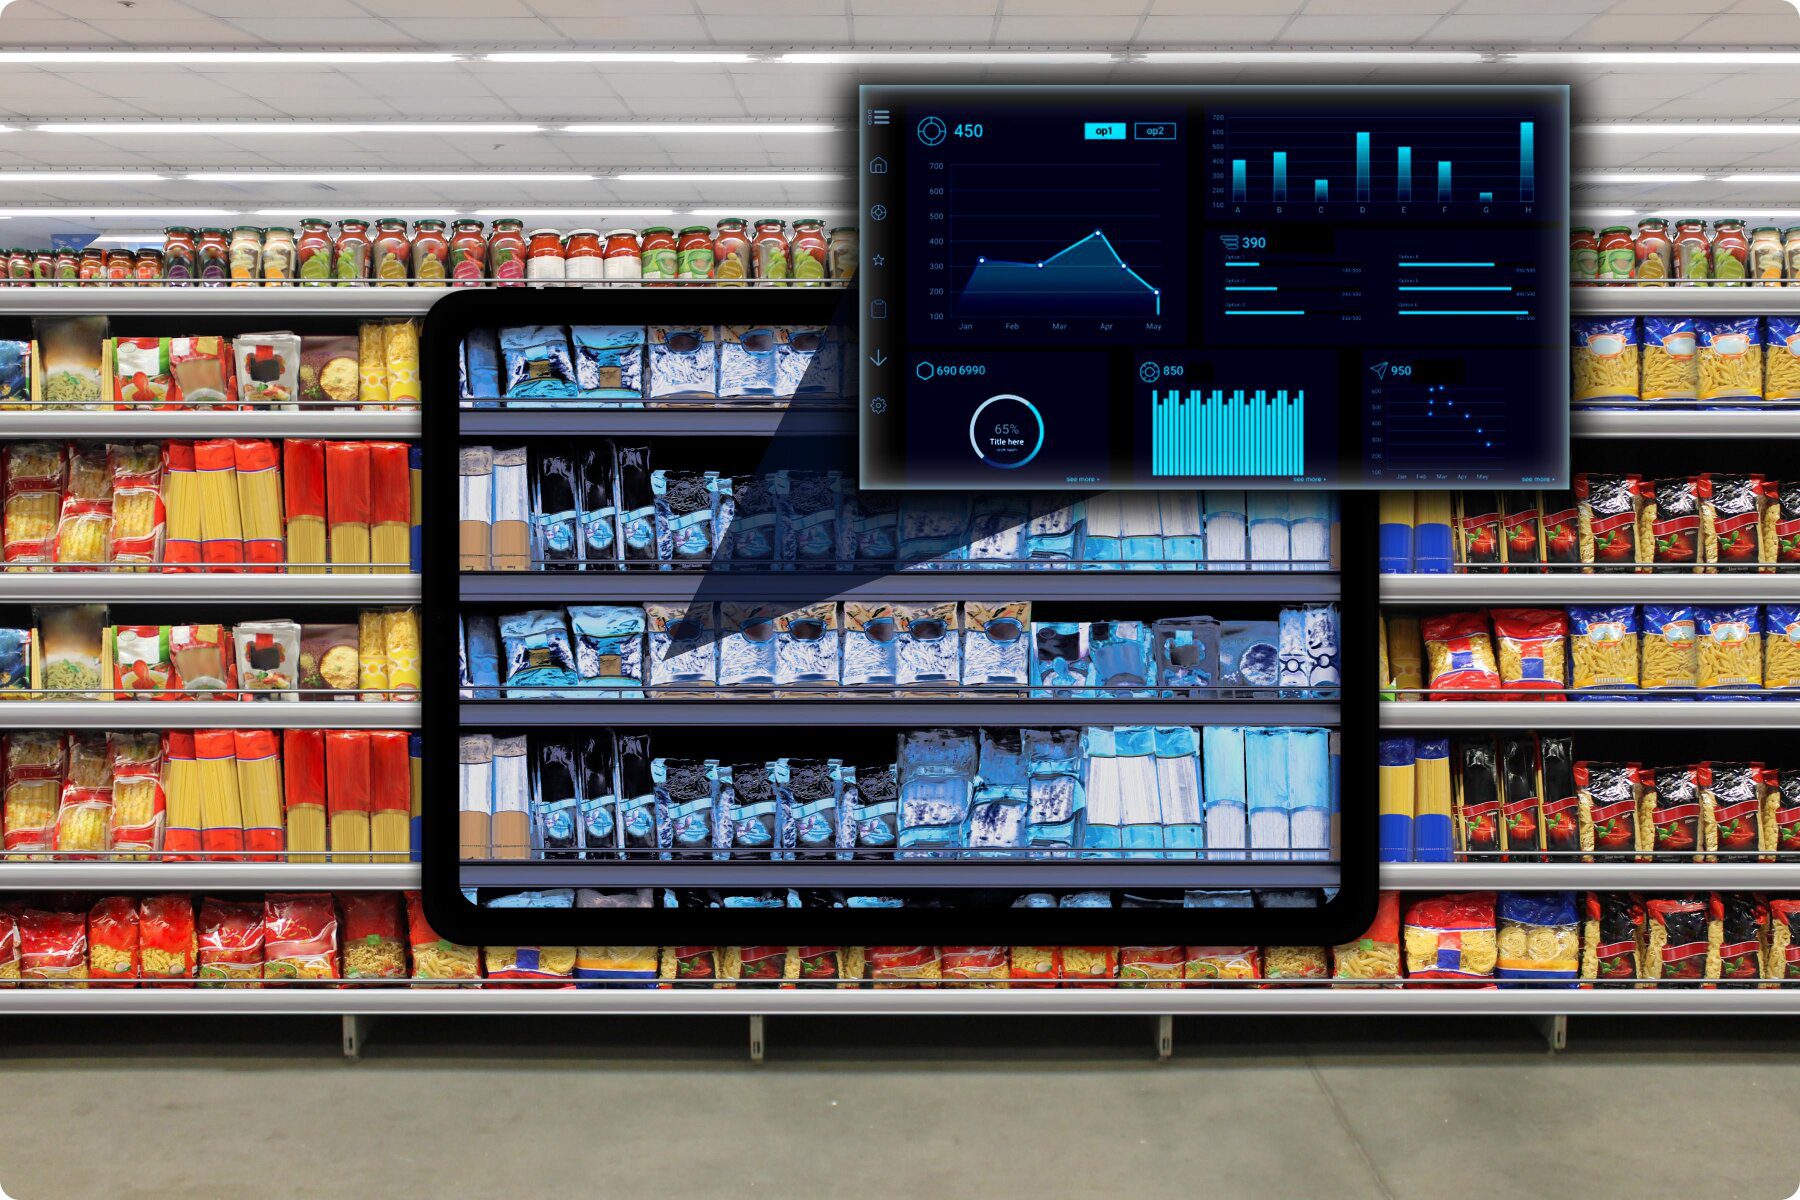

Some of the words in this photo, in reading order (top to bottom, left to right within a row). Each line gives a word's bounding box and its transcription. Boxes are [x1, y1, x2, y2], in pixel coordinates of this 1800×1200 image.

[954, 124, 984, 138] 450
[1095, 126, 1113, 136] op1
[1146, 126, 1164, 136] op2
[929, 187, 944, 195] 600
[1235, 206, 1241, 214] A
[1276, 206, 1282, 214] B
[1318, 206, 1324, 214] C
[1360, 206, 1366, 214] D
[1401, 206, 1407, 214] E
[1442, 206, 1448, 214] F
[1483, 206, 1489, 214] G
[1525, 206, 1531, 214] H
[1242, 237, 1266, 249] 390
[959, 322, 973, 331] Jan
[1005, 322, 1019, 331] Feb
[1052, 322, 1067, 331] Mar
[1100, 322, 1113, 331] Apr
[1146, 322, 1162, 331] May
[936, 366, 957, 376] 690
[959, 365, 986, 376] 6990
[1163, 366, 1184, 376] 850
[1391, 366, 1412, 376] 950
[994, 424, 1019, 435] 65%
[989, 438, 1006, 446] Title
[1007, 438, 1025, 446] here
